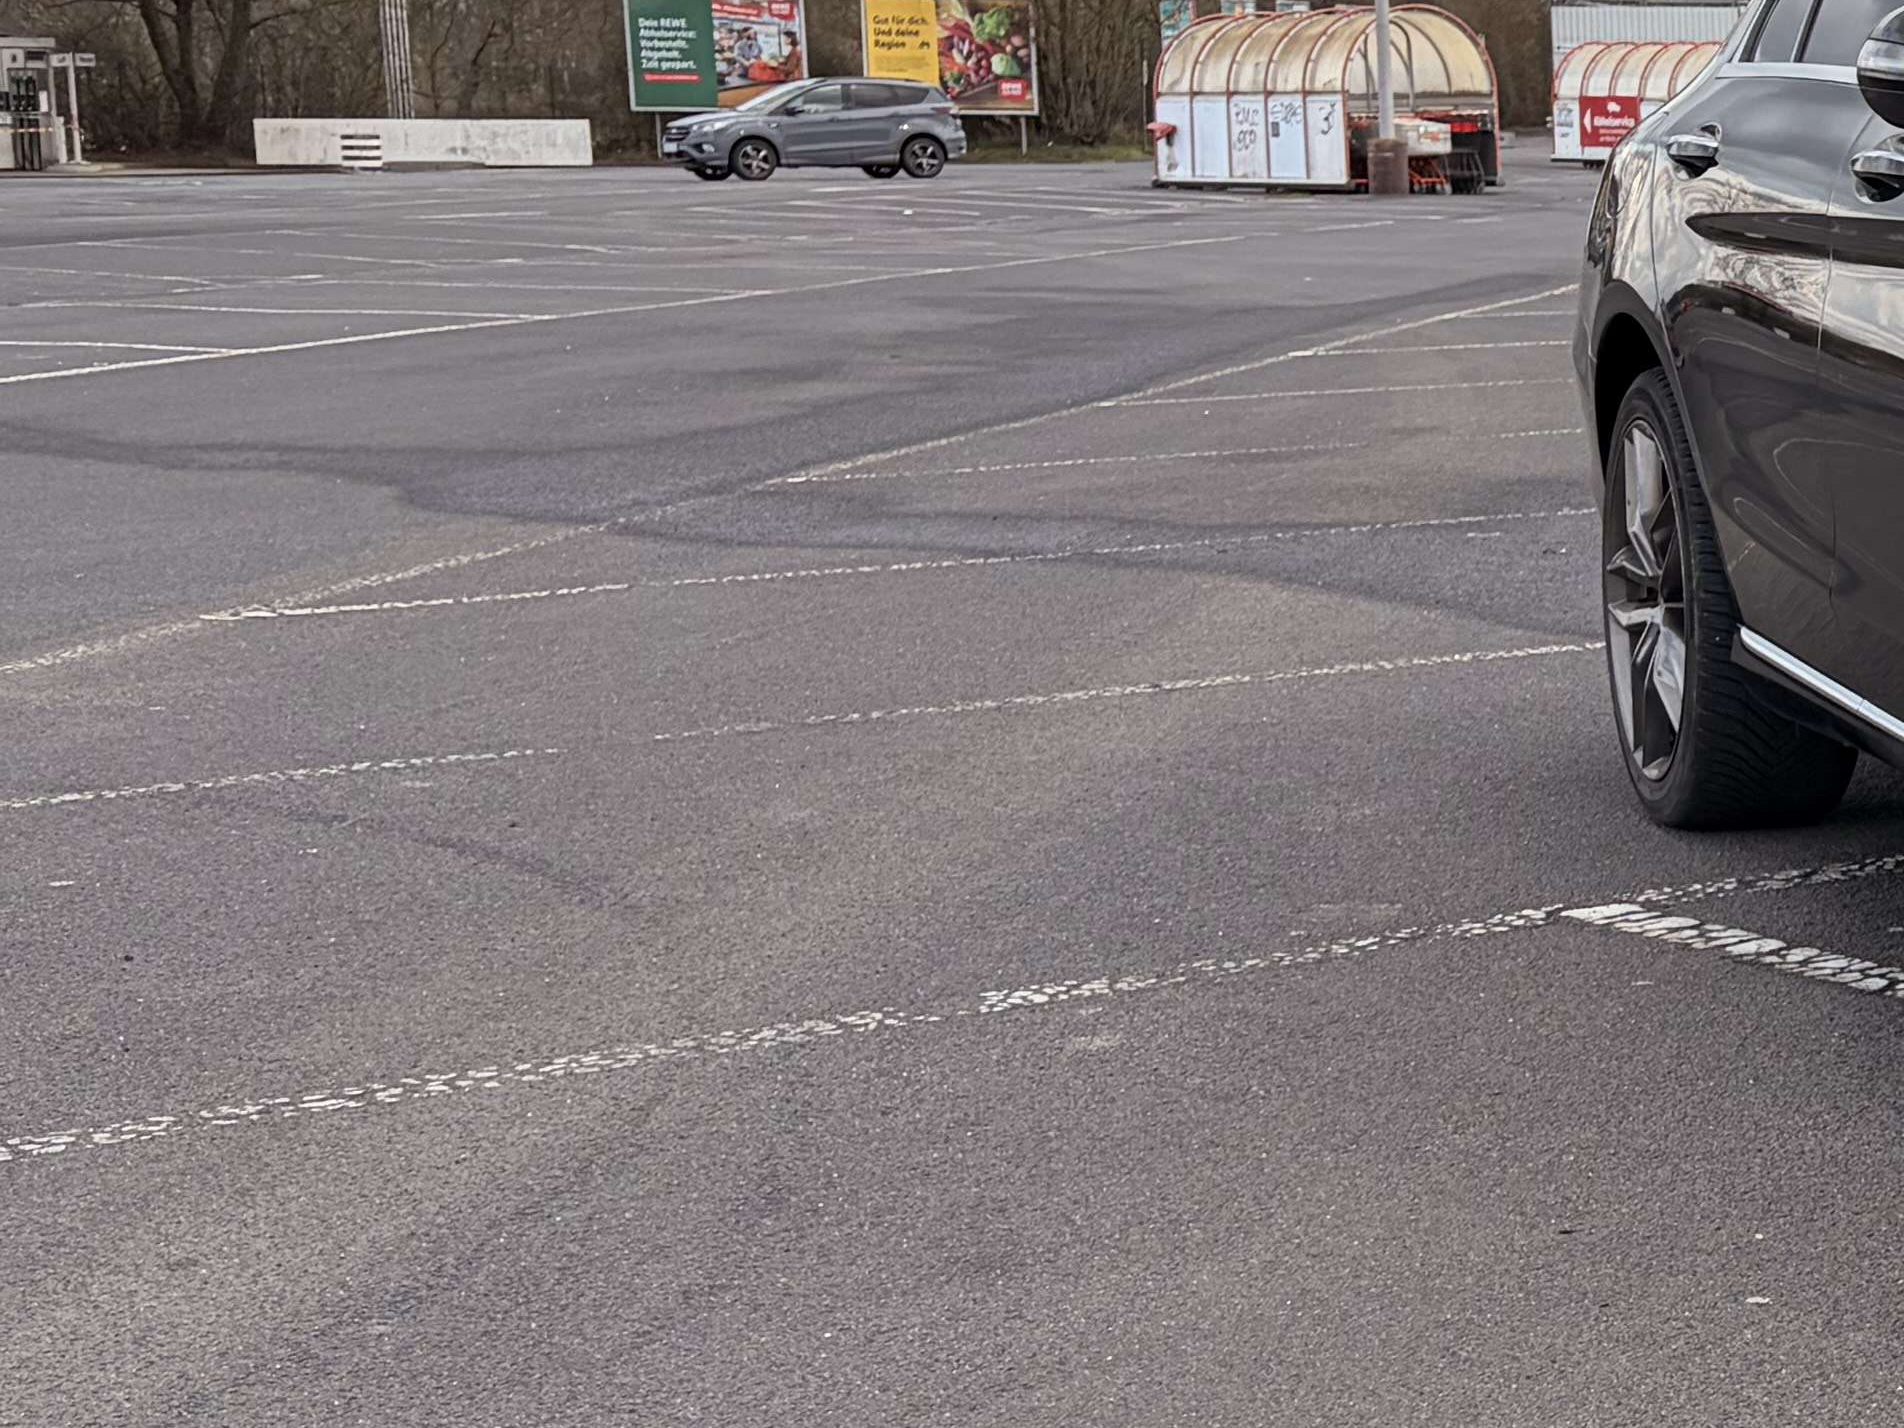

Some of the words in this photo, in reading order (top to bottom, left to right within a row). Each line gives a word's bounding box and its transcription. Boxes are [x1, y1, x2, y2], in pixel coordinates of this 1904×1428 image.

[638, 17, 658, 27] Dein
[873, 15, 889, 25] Gut
[891, 14, 905, 25] für
[873, 27, 892, 37] Und
[895, 27, 920, 37] deine
